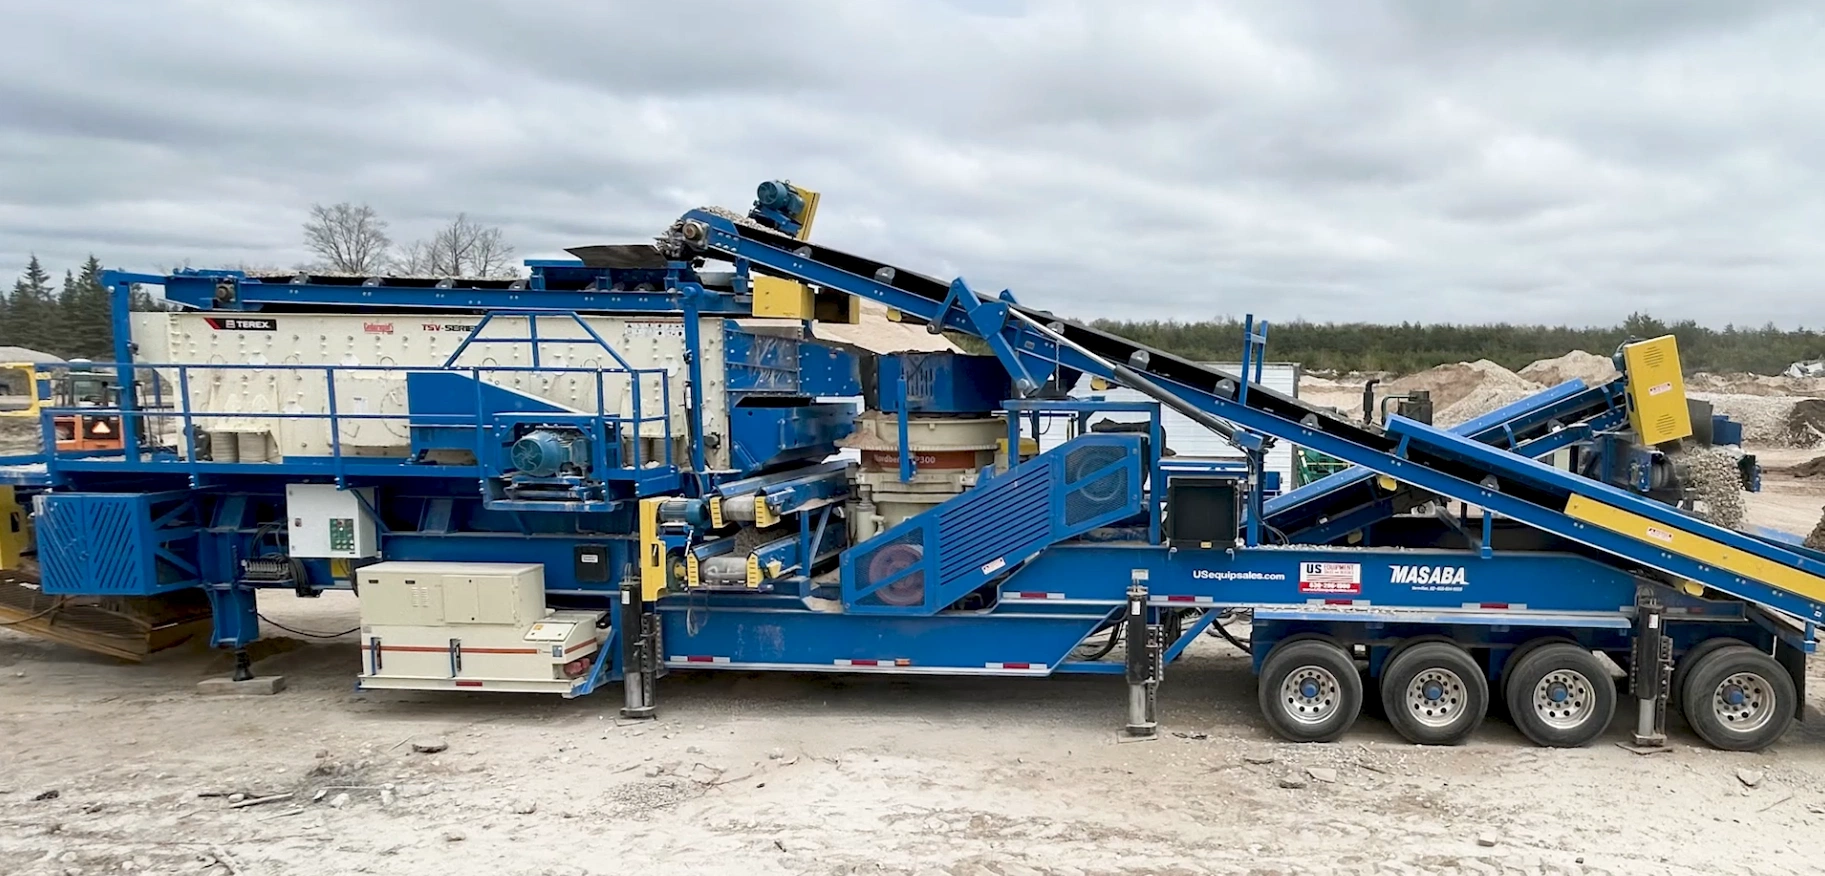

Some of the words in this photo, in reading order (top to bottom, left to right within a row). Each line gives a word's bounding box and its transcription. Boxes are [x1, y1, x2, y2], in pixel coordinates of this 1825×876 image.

[236, 320, 270, 328] TEREX
[1306, 564, 1322, 574] US
[1192, 569, 1285, 581] USequipsales.com
[1388, 565, 1470, 585] MASABA
